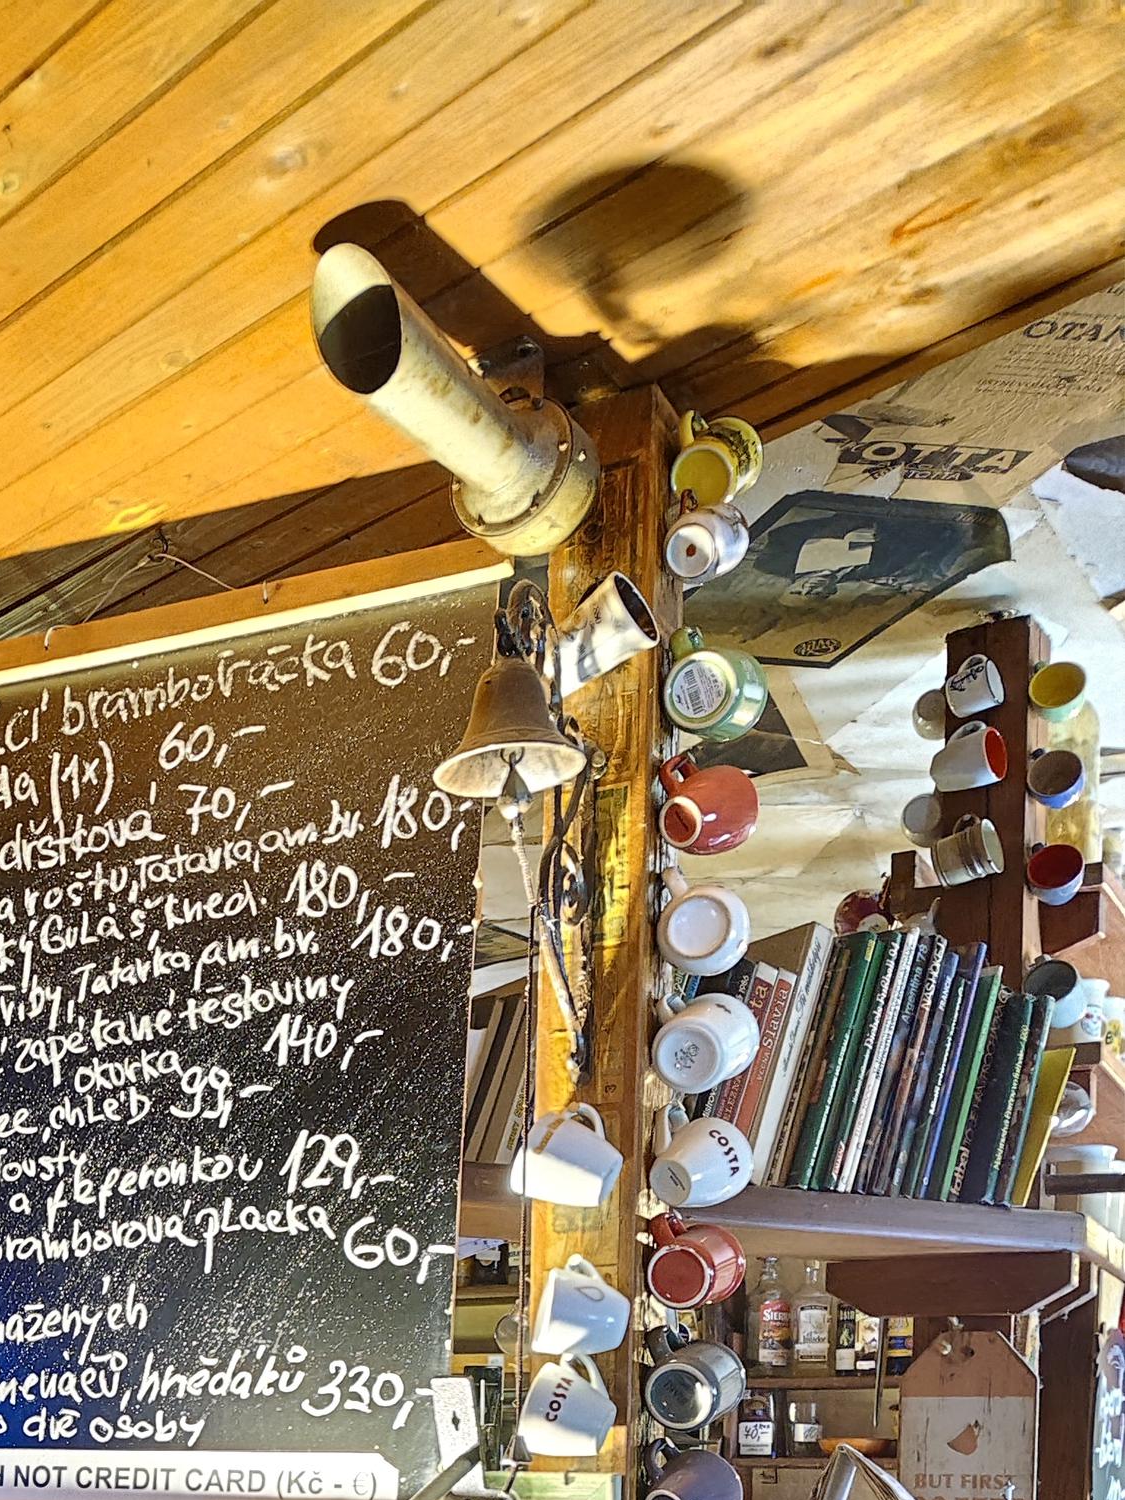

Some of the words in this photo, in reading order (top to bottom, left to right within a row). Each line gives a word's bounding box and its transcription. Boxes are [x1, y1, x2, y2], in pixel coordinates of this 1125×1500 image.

[371, 620, 477, 688] 60,-
[49, 739, 116, 824] (1x)
[157, 720, 268, 771] 60,-
[176, 779, 296, 836] 70,-
[285, 859, 416, 925] 180,-
[263, 1012, 384, 1071] 140,-
[761, 986, 790, 1050] Slavia
[9, 1192, 32, 1215] a
[279, 1129, 397, 1200] 129,-
[708, 1128, 740, 1178] COSTA
[342, 1215, 457, 1285] 60,-
[301, 1359, 436, 1431] 330,-
[544, 1376, 576, 1423] COSTA
[88, 1407, 206, 1448] osoby
[13, 1464, 68, 1489] NOT
[76, 1465, 177, 1491] CREDIT
[184, 1467, 267, 1494] CARD
[914, 1473, 955, 1490] BUT
[960, 1474, 1018, 1490] FIRST
